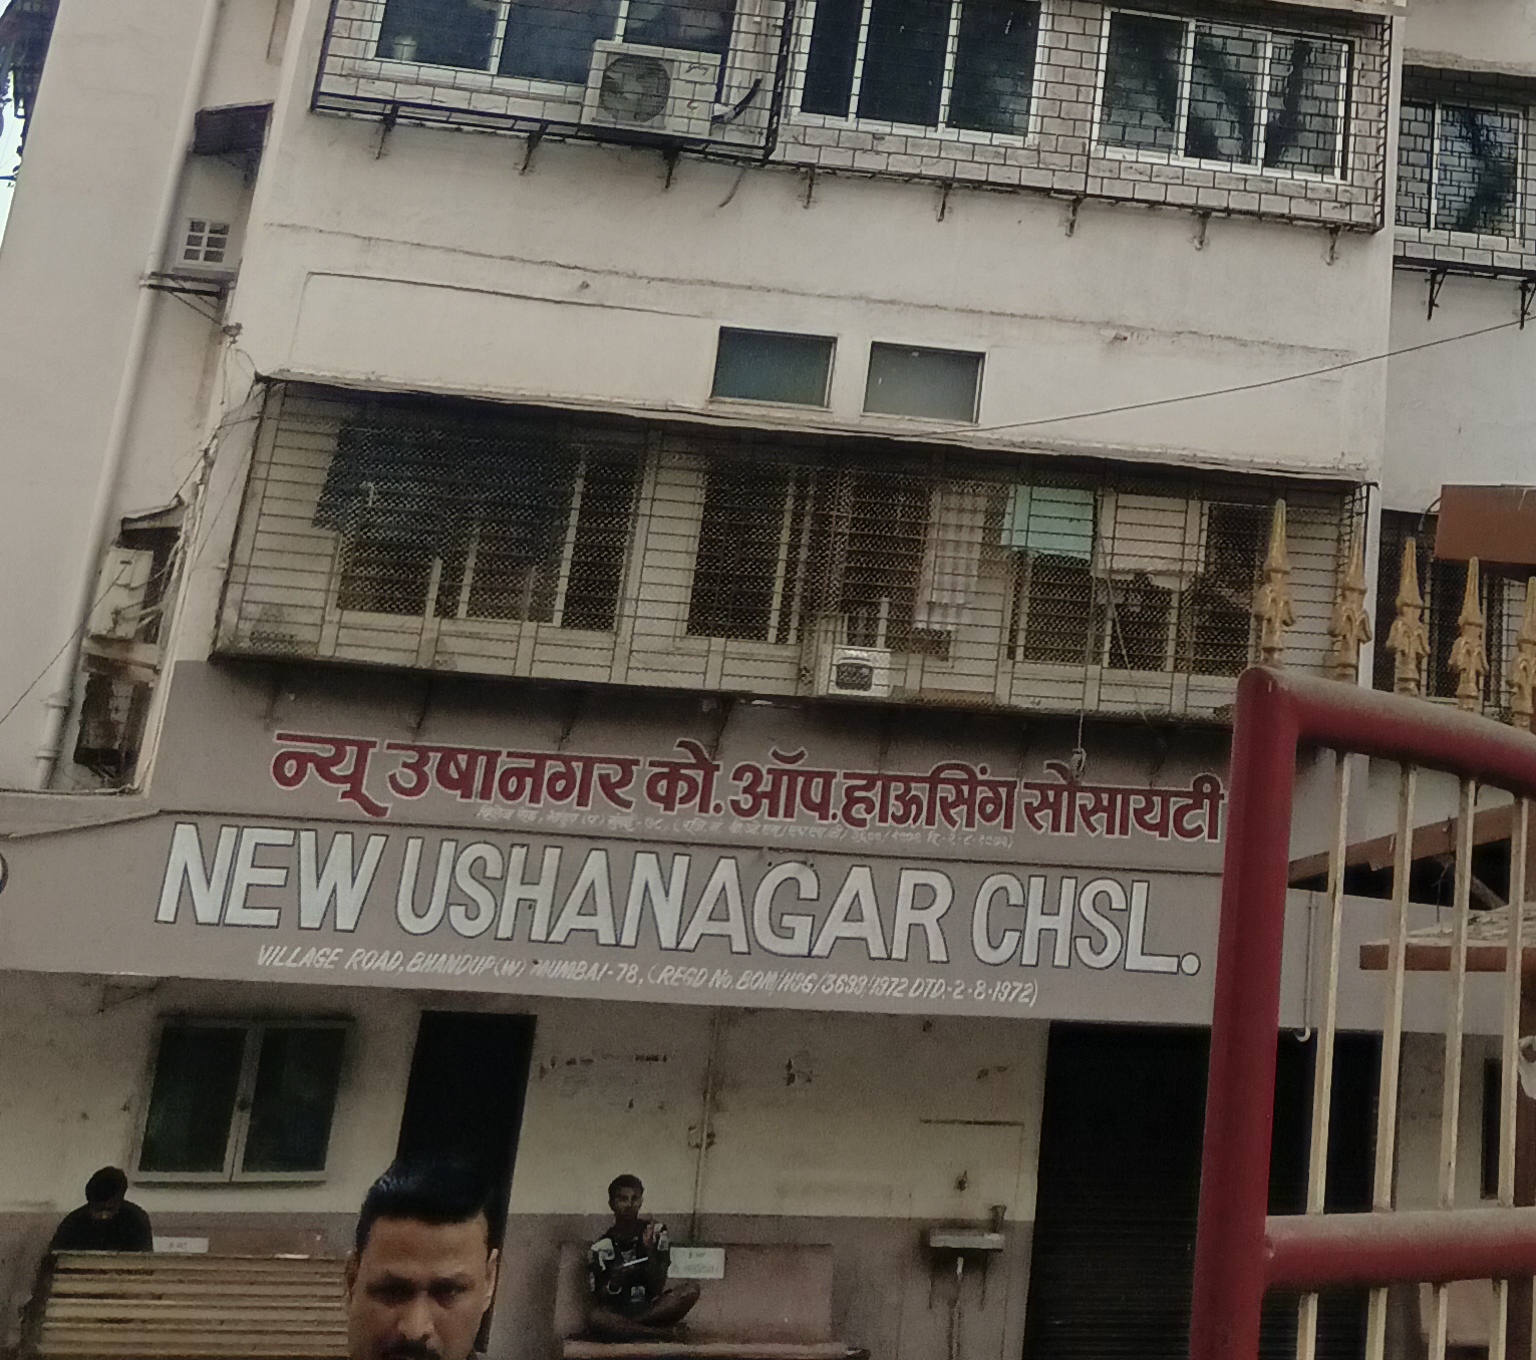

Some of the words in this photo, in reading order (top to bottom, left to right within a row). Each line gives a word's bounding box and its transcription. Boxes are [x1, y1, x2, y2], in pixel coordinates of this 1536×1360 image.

[270, 730, 392, 819] न्यू
[384, 738, 640, 813] उषानगर
[1020, 760, 1229, 844] सोसायटी
[154, 821, 390, 933] NEW
[396, 836, 956, 964] USHANAGAR
[971, 871, 1202, 976] CHSL.
[257, 944, 344, 969] VILLAGE
